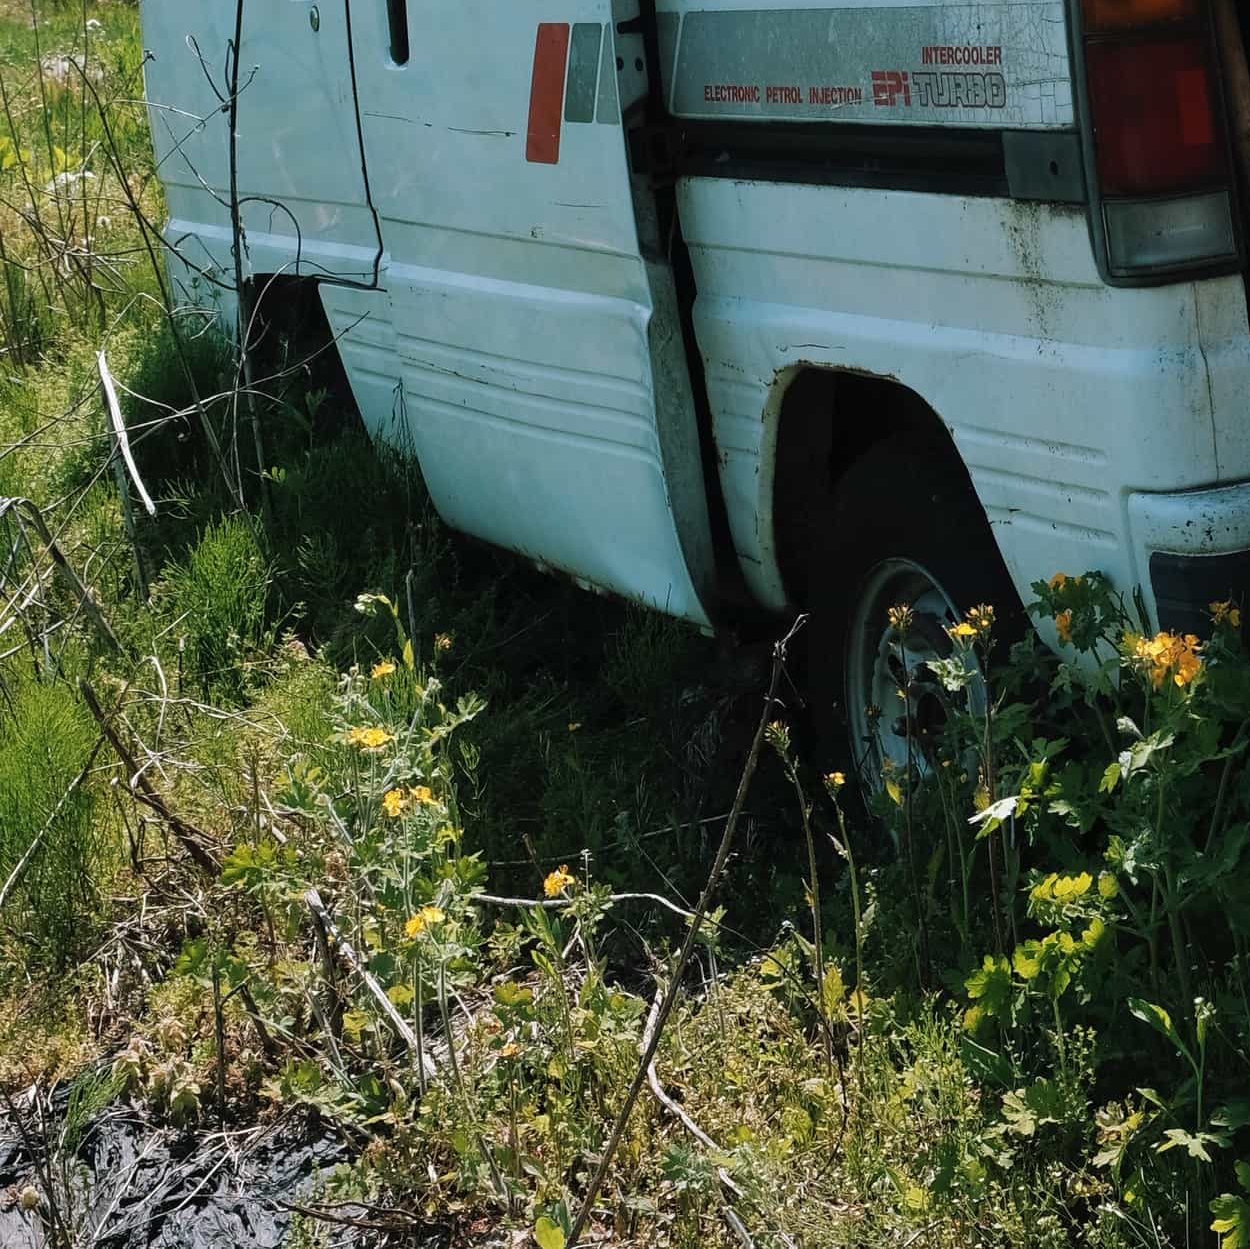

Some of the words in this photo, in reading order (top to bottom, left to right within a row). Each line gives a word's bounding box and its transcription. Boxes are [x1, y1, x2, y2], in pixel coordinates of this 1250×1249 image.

[922, 46, 1003, 65] INTERCOOLER
[703, 85, 760, 103] ELECTRONIC
[766, 86, 803, 104] PETROL
[808, 87, 862, 105] INJECTION
[912, 71, 1007, 108] TURBO
